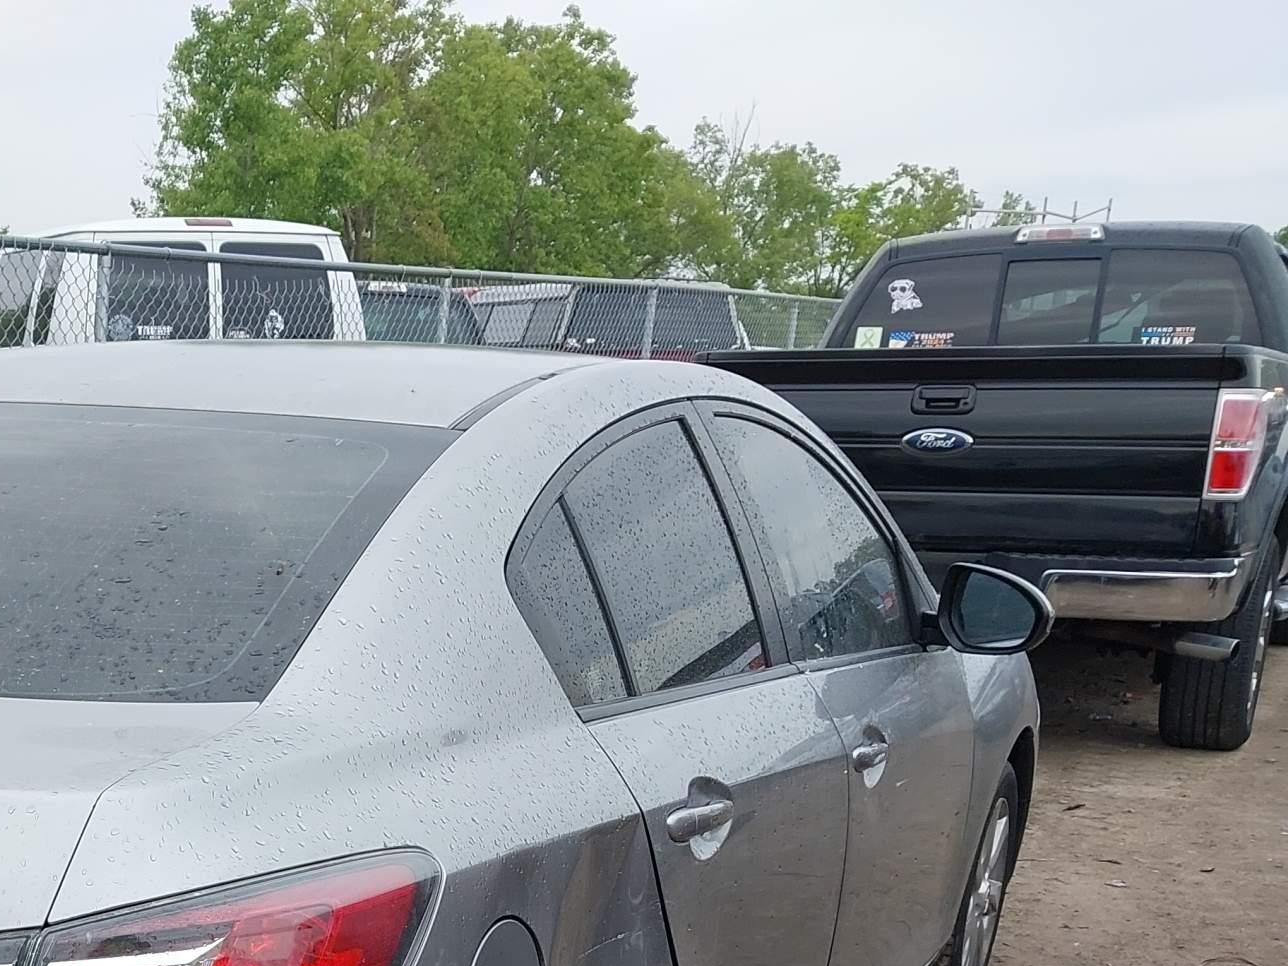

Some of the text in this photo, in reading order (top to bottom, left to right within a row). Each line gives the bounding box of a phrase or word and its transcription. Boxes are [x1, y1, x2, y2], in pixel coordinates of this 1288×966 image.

[913, 332, 955, 341] TRUMP
[1140, 336, 1195, 345] TRUMP
[916, 432, 956, 449] Ford
